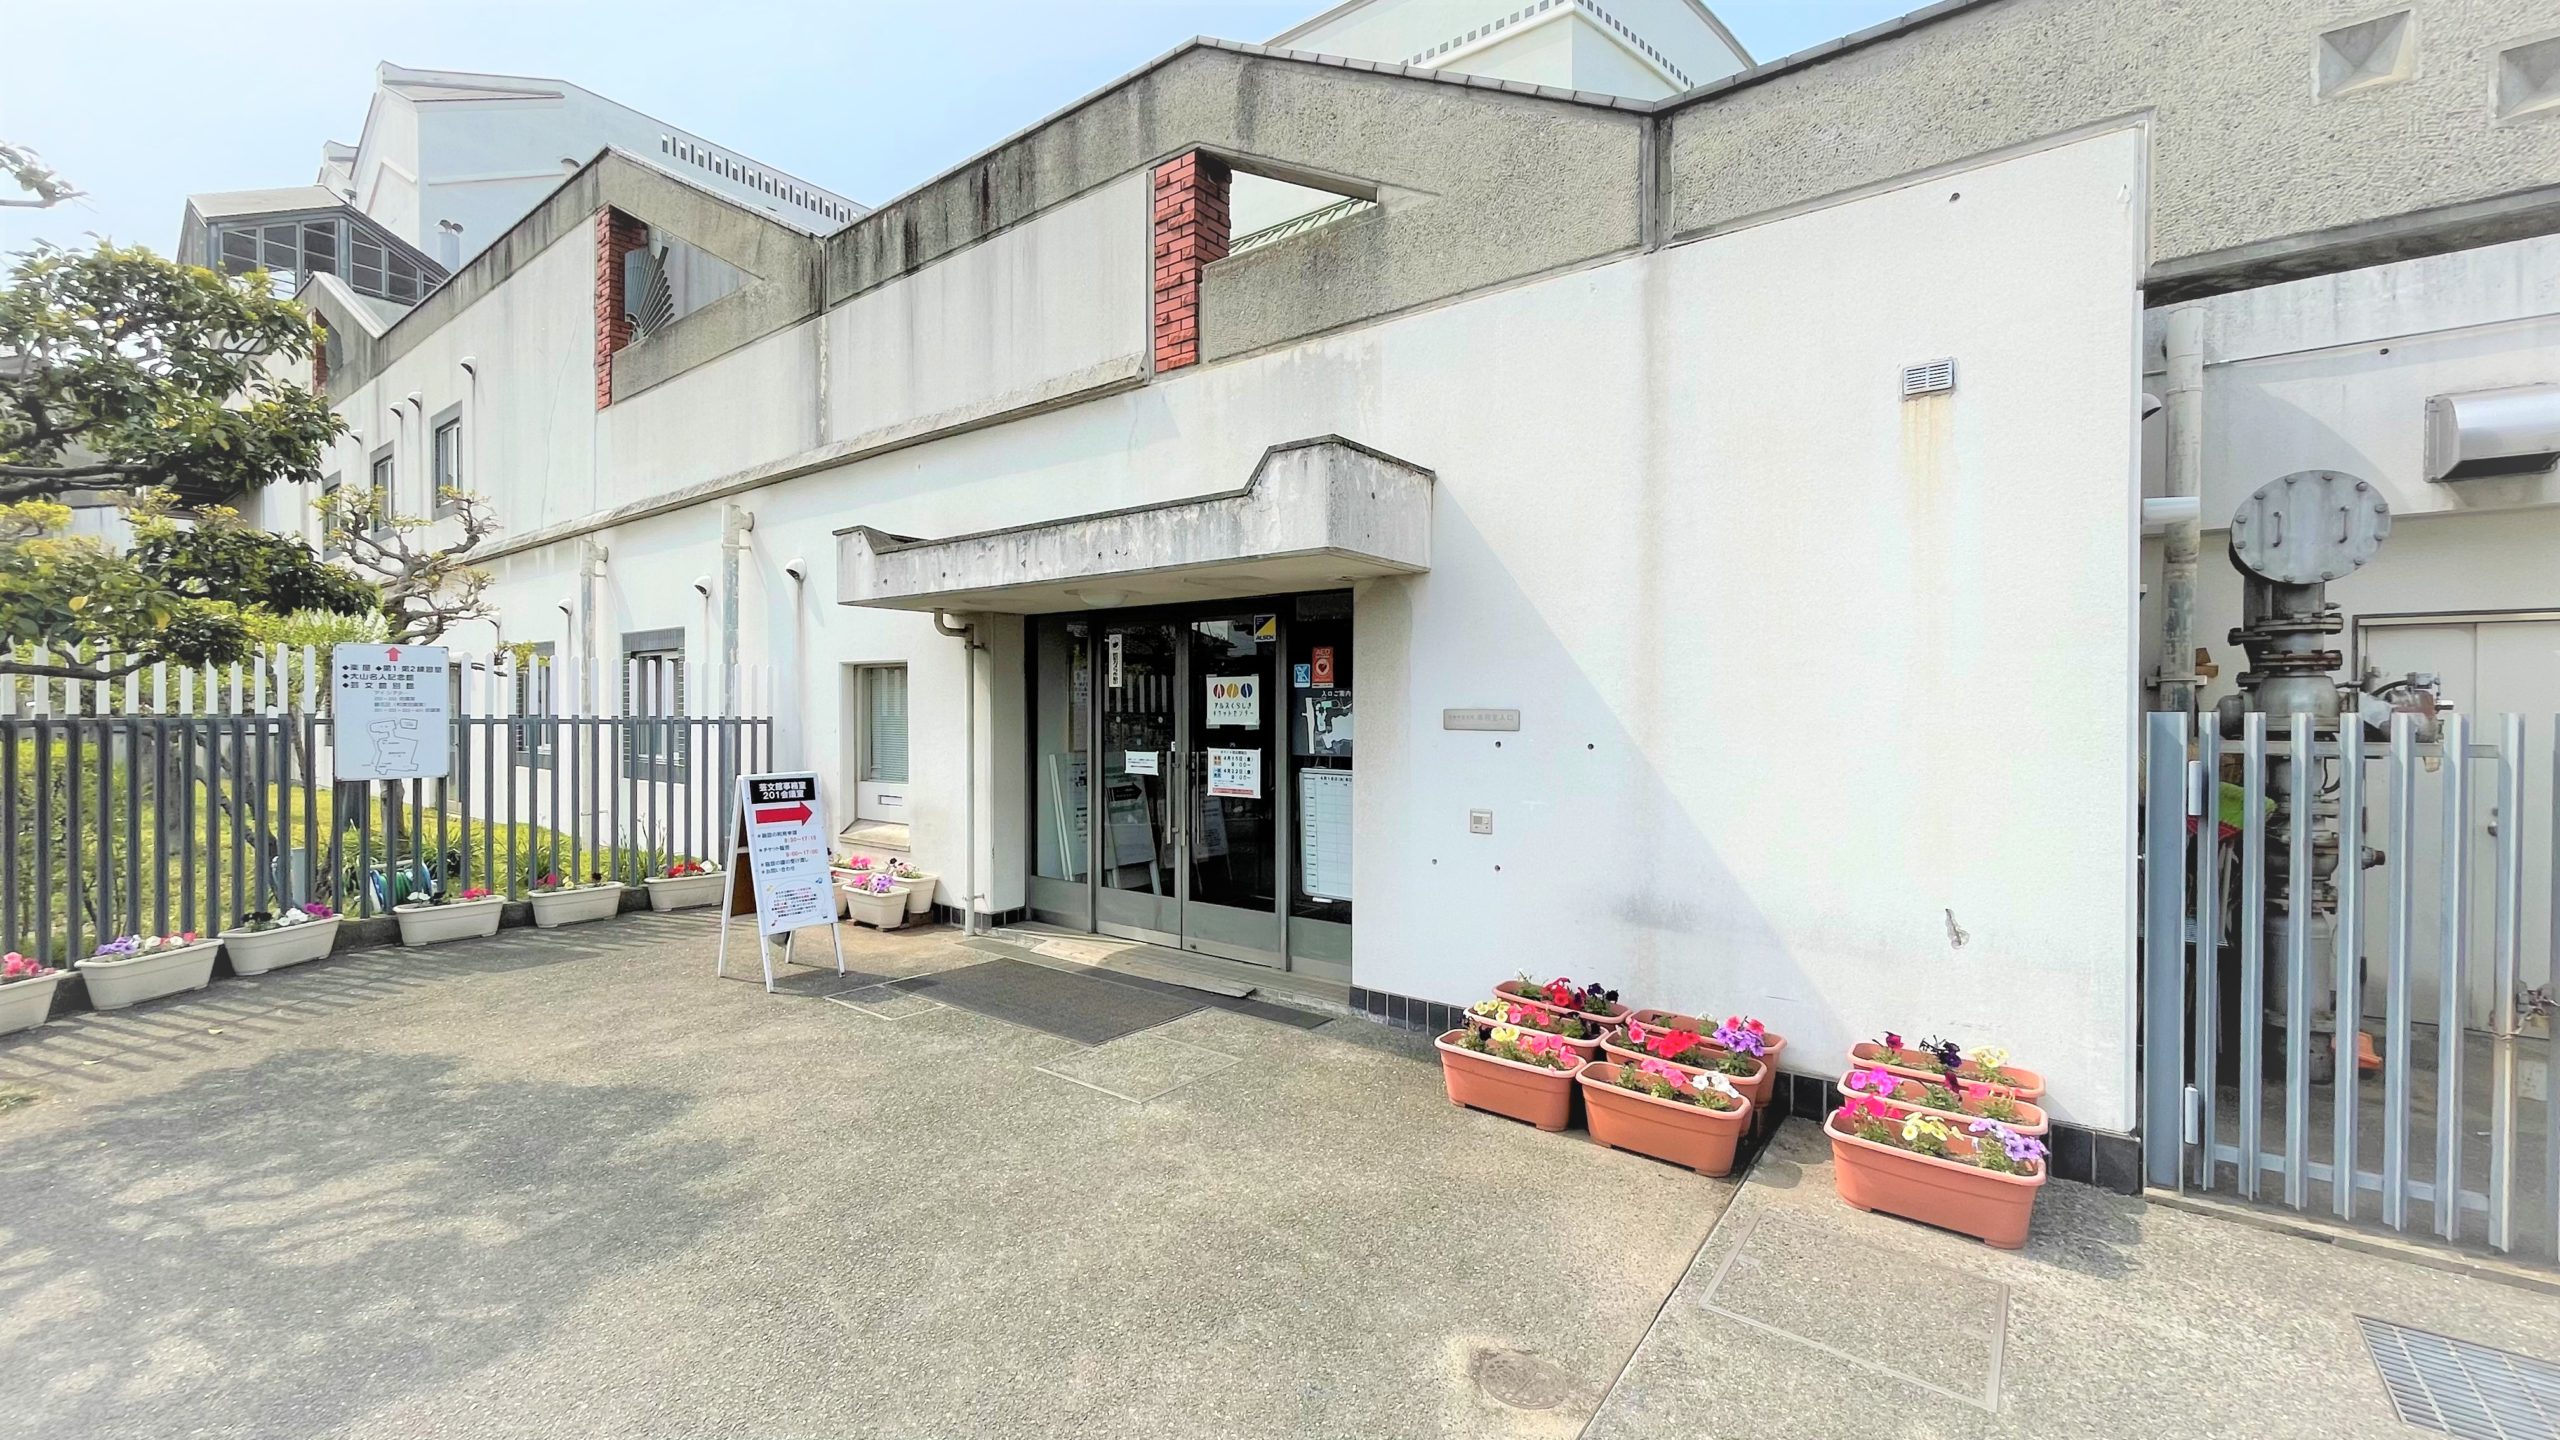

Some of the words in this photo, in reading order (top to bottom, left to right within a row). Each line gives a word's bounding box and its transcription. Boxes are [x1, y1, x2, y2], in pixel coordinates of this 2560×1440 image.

[350, 673, 415, 681] 大山名人記念館
[758, 781, 807, 792] 芸文館事務室
[762, 789, 805, 800] 201会議室
